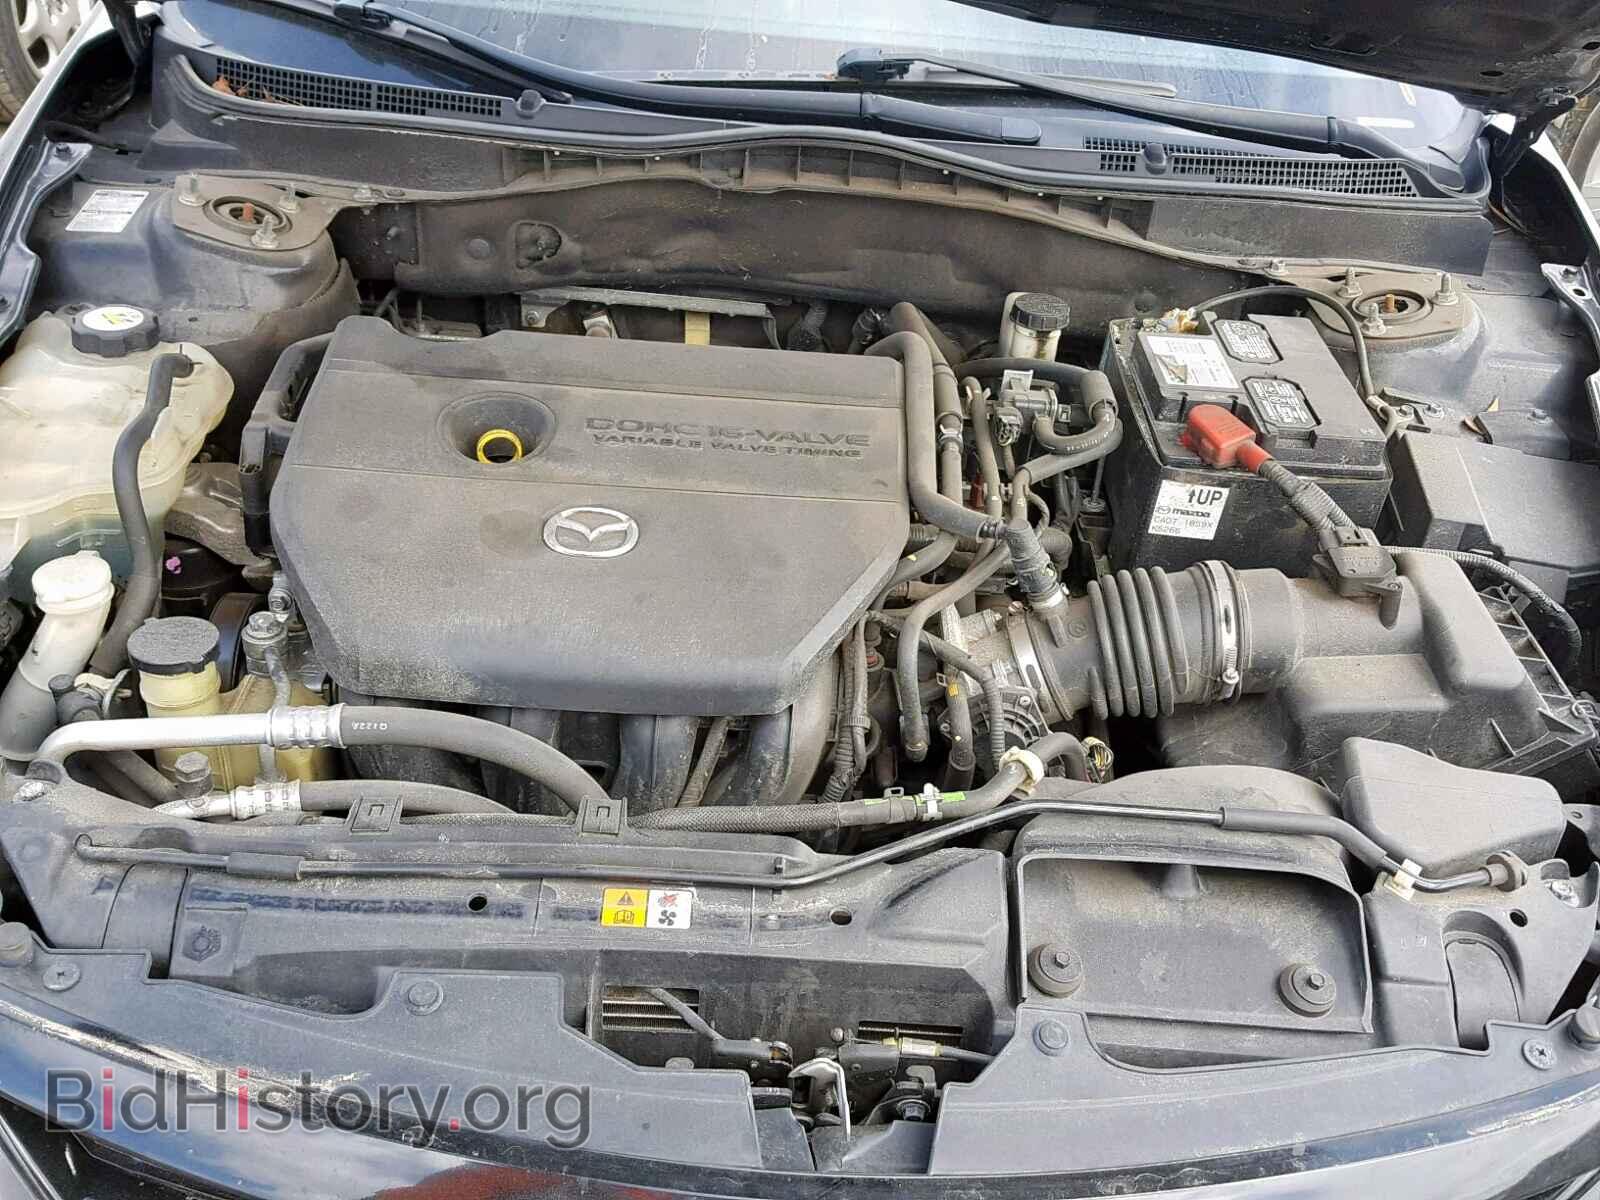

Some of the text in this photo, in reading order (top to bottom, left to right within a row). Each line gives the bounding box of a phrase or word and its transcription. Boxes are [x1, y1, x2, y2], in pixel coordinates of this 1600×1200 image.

[585, 417, 870, 446] DOHC 16-VALVE
[593, 433, 862, 458] VARIABLE VALVE TIMING
[1197, 488, 1223, 506] UP
[1172, 507, 1211, 518] mazda
